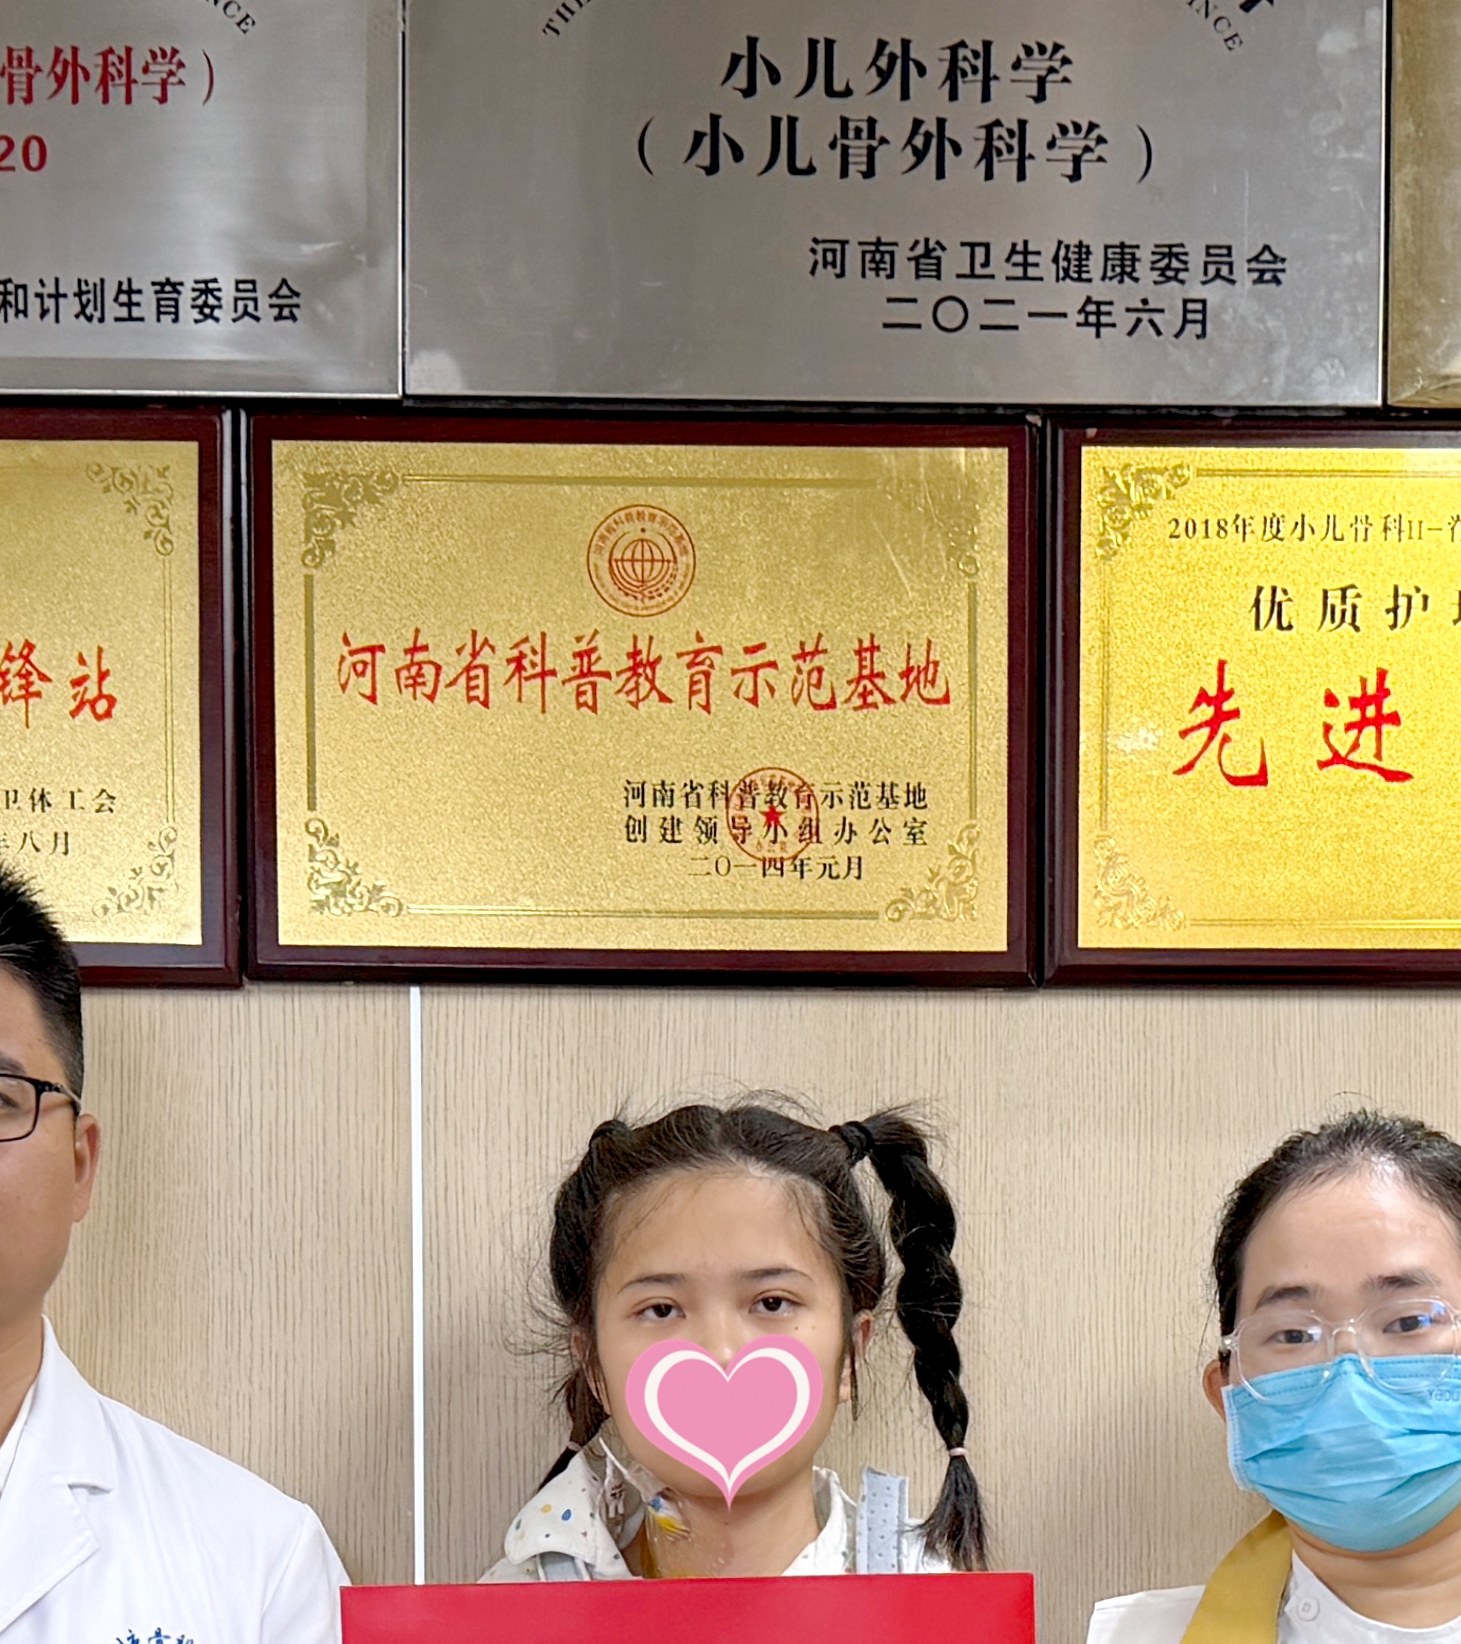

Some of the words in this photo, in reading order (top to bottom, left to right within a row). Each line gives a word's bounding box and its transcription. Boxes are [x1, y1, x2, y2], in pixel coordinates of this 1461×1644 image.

[720, 37, 1076, 105] 小儿外科学
[807, 236, 1288, 289] 河南省卫生健康委员会
[337, 626, 952, 716] 河南省科普教育示范基地
[623, 778, 929, 811] 河南省科普教育示范基地
[623, 814, 929, 846] 创建领导小组办公室
